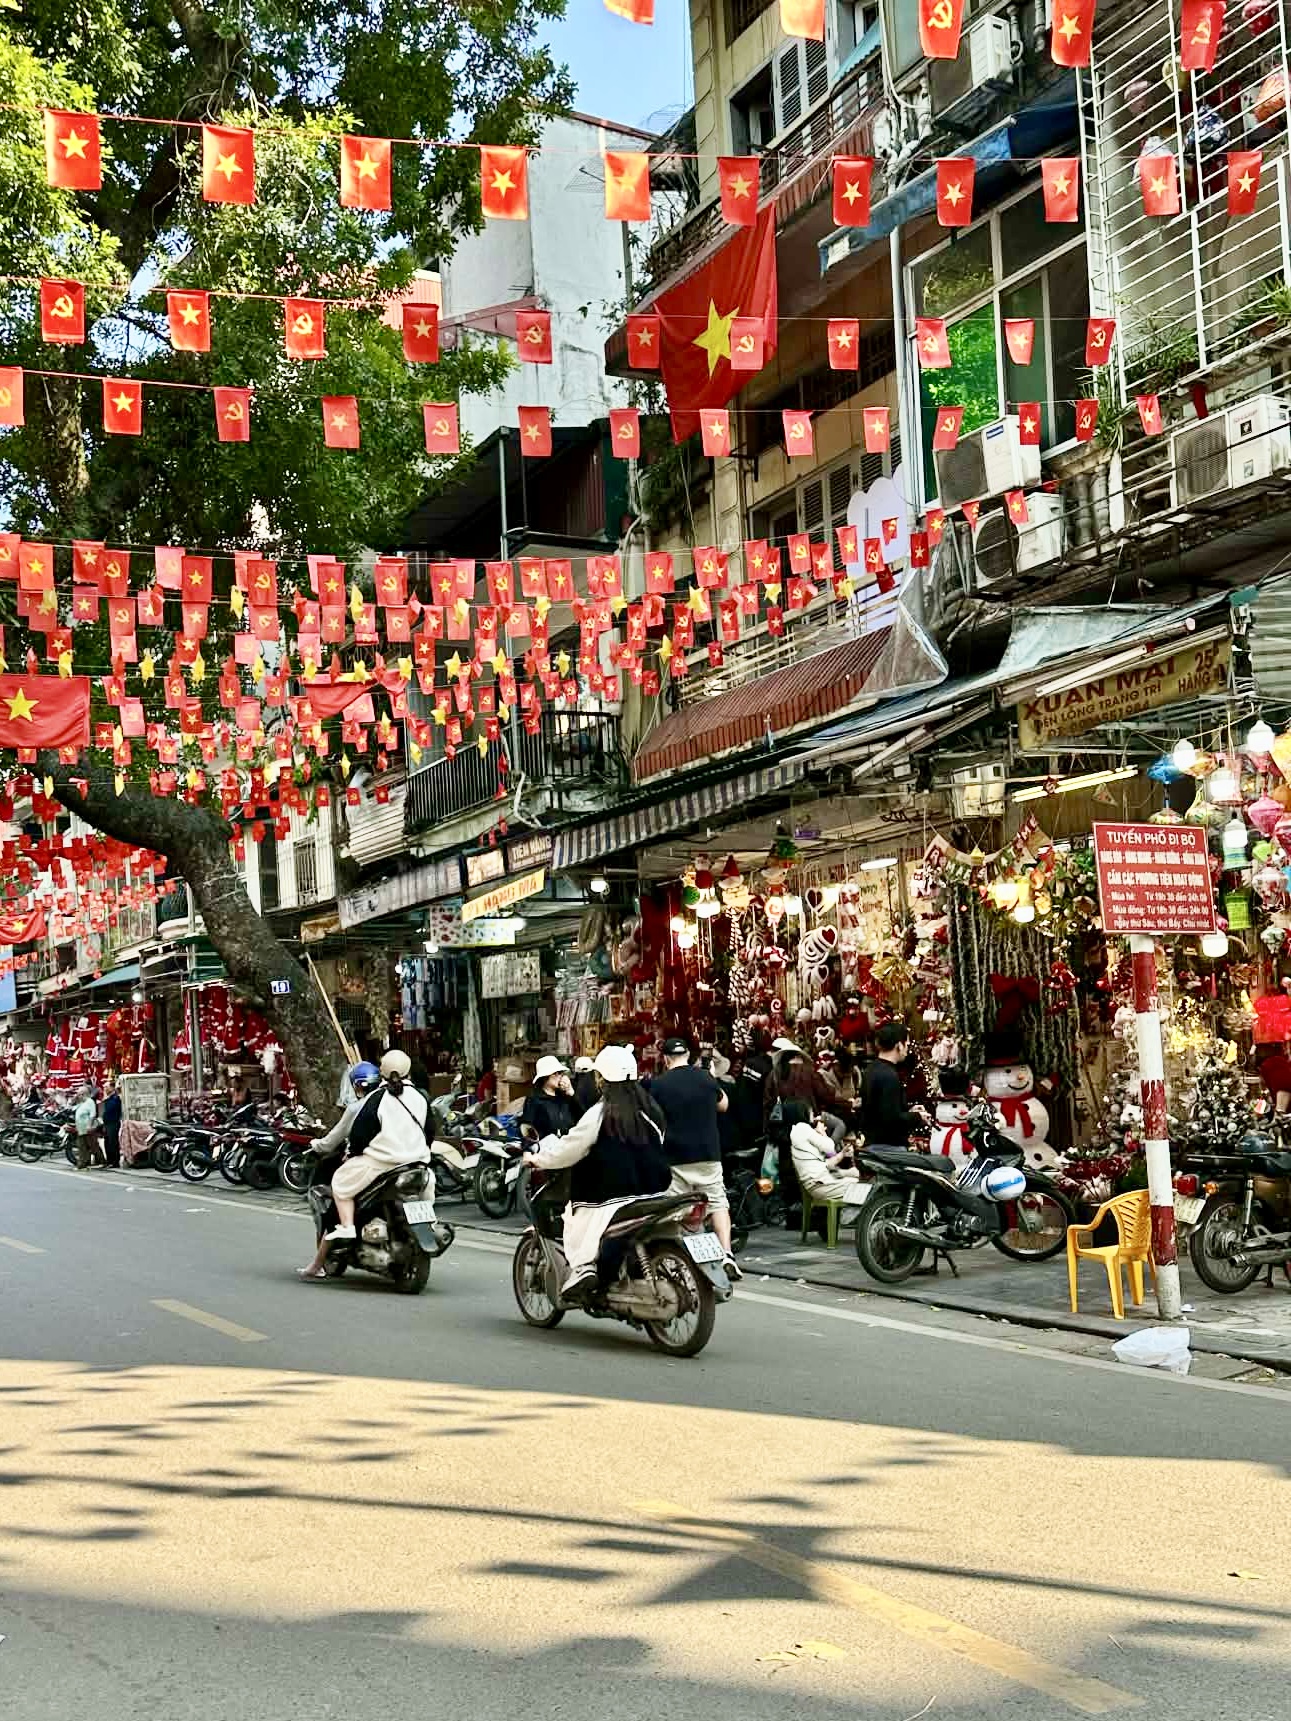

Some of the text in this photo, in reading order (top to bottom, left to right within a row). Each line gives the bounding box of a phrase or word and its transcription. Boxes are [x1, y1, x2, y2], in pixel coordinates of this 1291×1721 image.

[1099, 690, 1139, 709] TRANG
[1107, 828, 1196, 848] TUYẾN PHỐ ĐI BỘ
